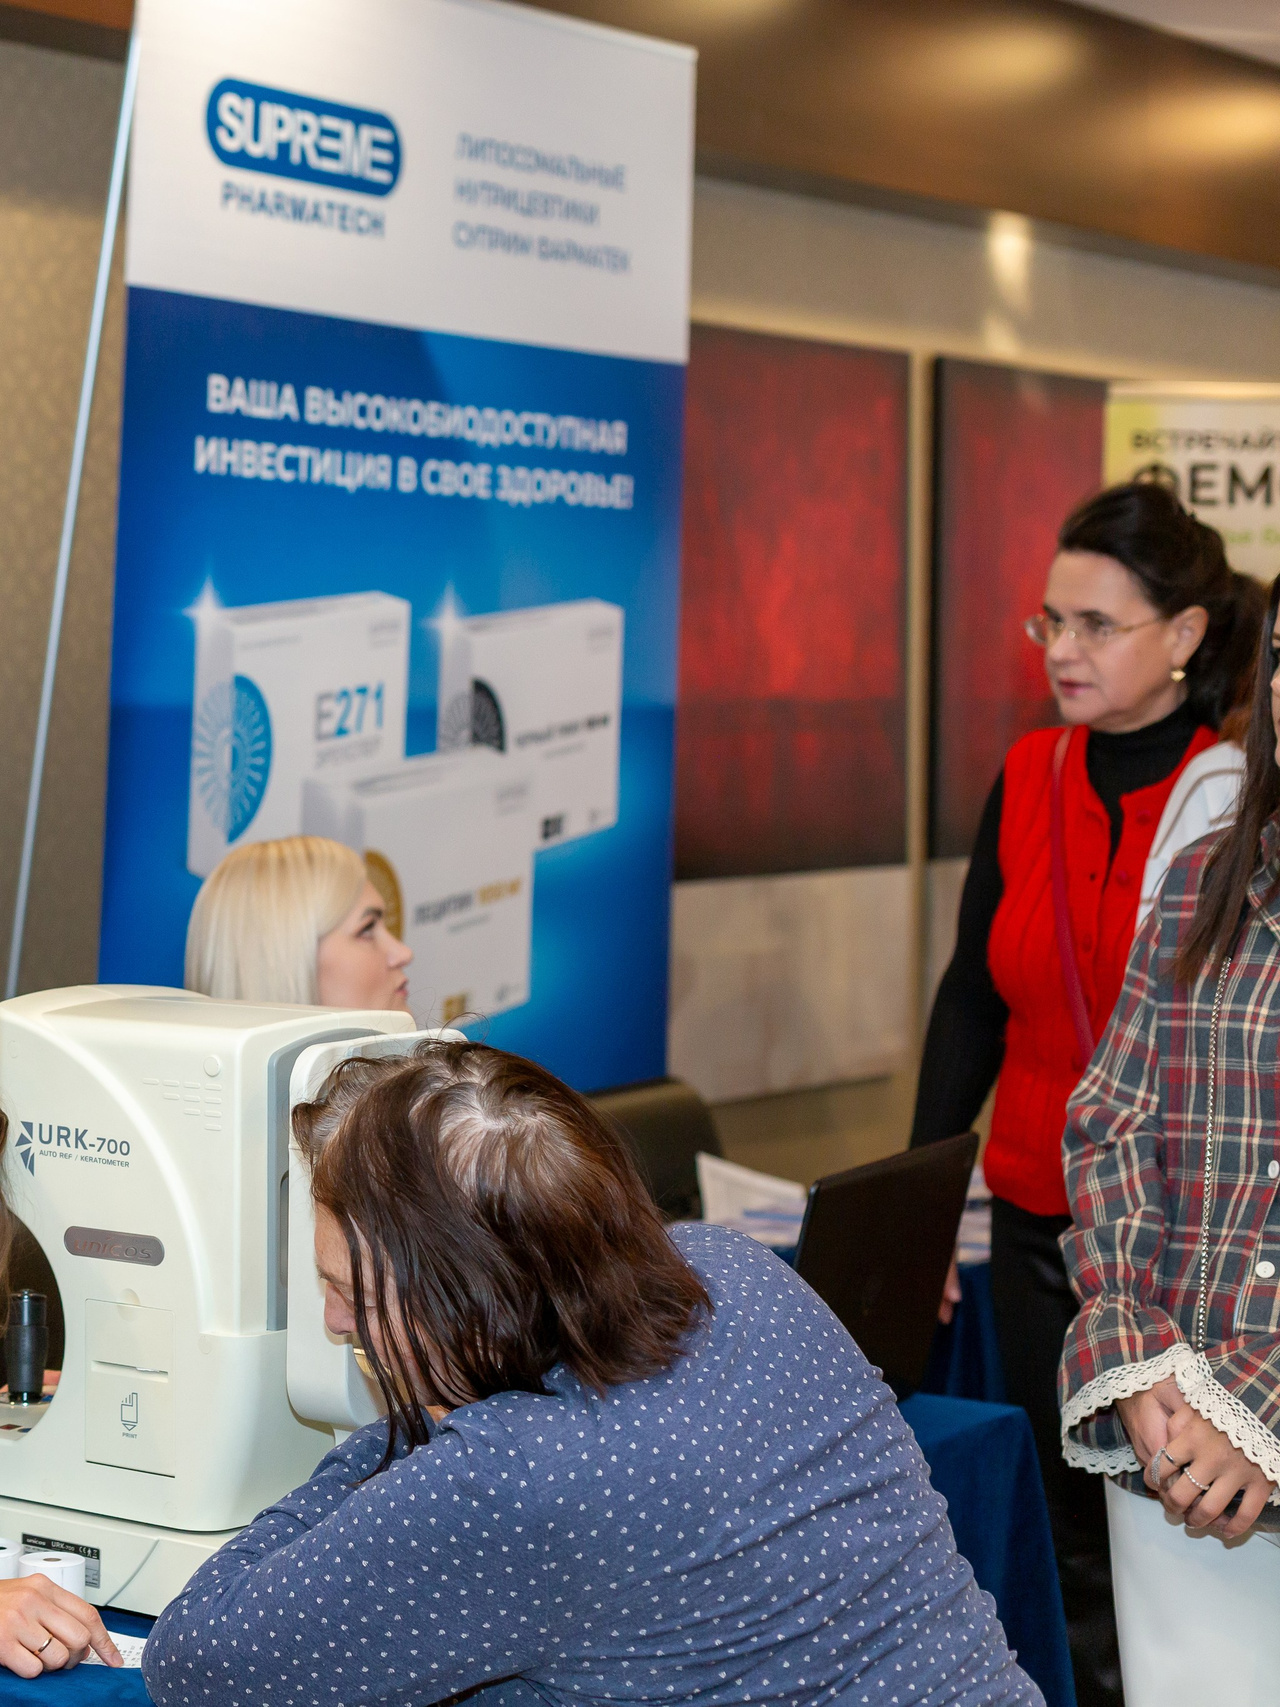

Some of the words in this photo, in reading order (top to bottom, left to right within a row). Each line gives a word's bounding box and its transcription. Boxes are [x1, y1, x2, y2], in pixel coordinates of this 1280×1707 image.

[215, 92, 394, 184] SUPREME
[222, 181, 385, 237] PHARMATECH
[207, 373, 300, 422] ВАША
[304, 385, 628, 455] ВЫСОКОБИОДОСТУПНАЯ
[194, 434, 393, 493] ИНВЕСТИЦИЯ
[397, 456, 419, 493] В
[421, 458, 493, 500] СВОЕ
[38, 1122, 131, 1156] URK-700
[38, 1149, 58, 1158] AUTO
[59, 1151, 73, 1160] REF
[80, 1155, 130, 1168] KERATOMETER
[73, 1236, 152, 1260] unicos
